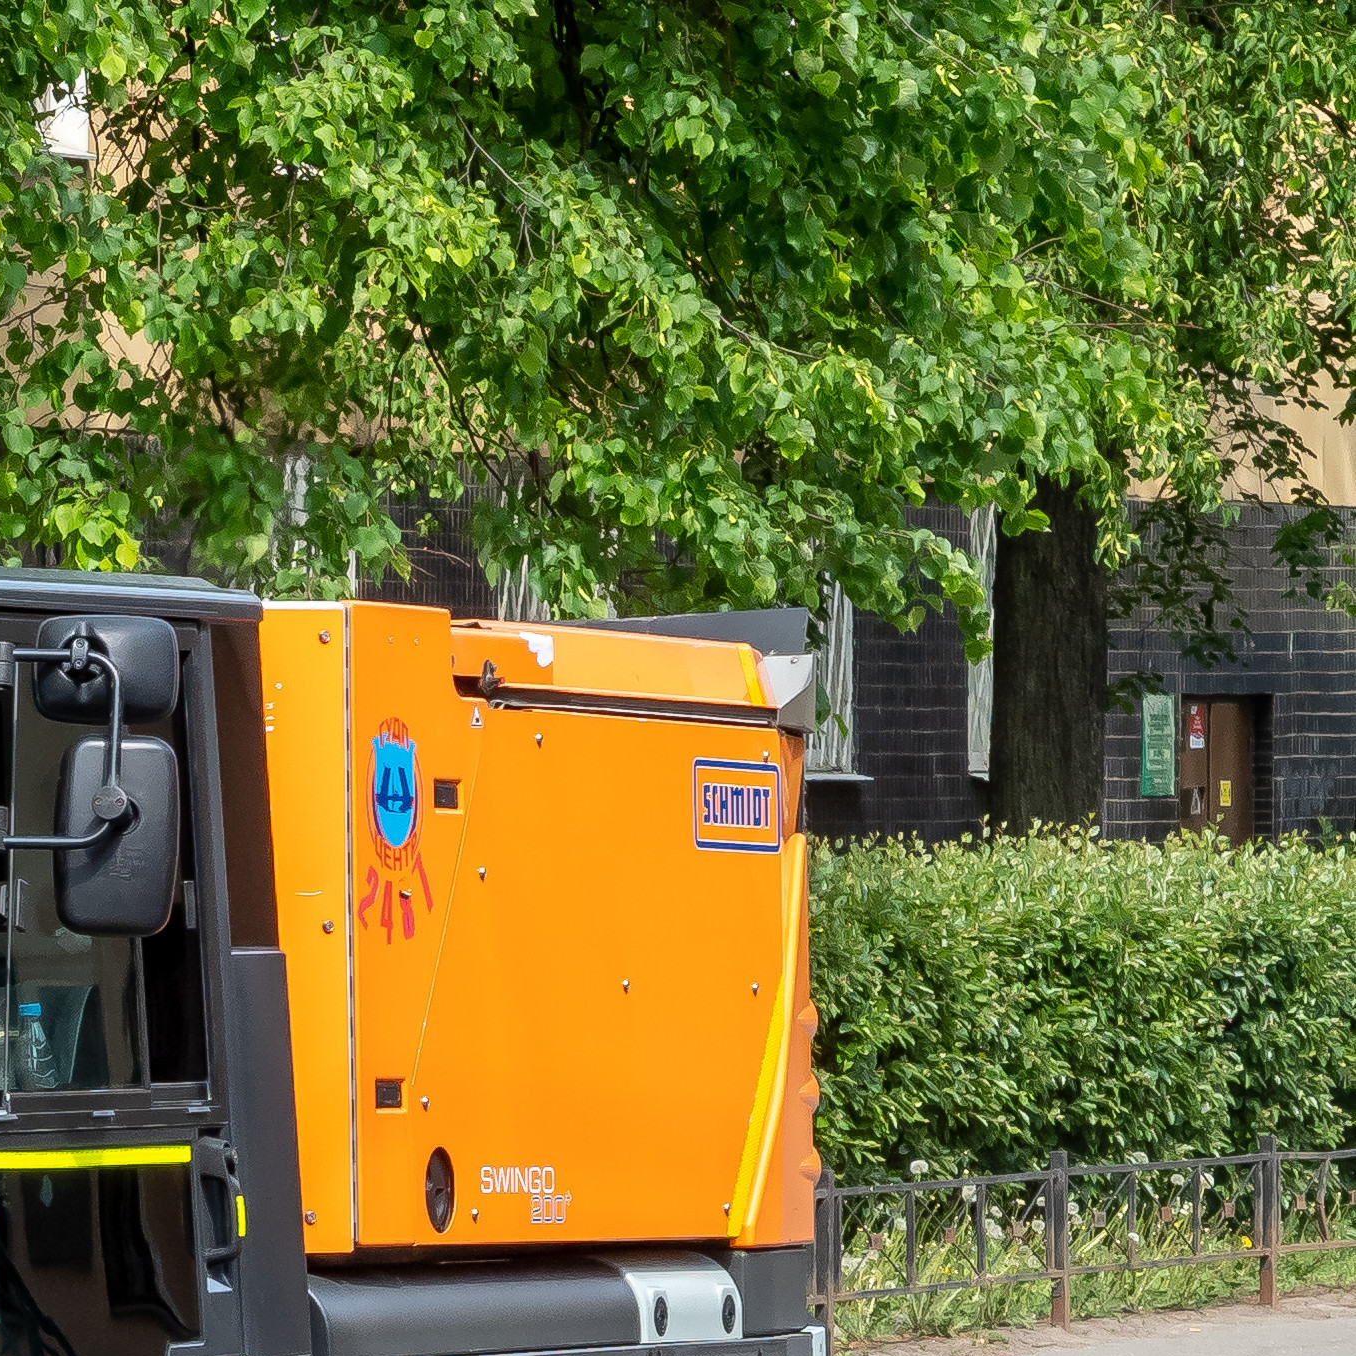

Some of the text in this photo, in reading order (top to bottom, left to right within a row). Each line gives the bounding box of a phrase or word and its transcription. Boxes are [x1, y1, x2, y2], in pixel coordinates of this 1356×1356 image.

[702, 782, 772, 829] SCHMIDT
[375, 831, 417, 871] ЦЕНТР
[480, 1166, 555, 1194] SWINGO
